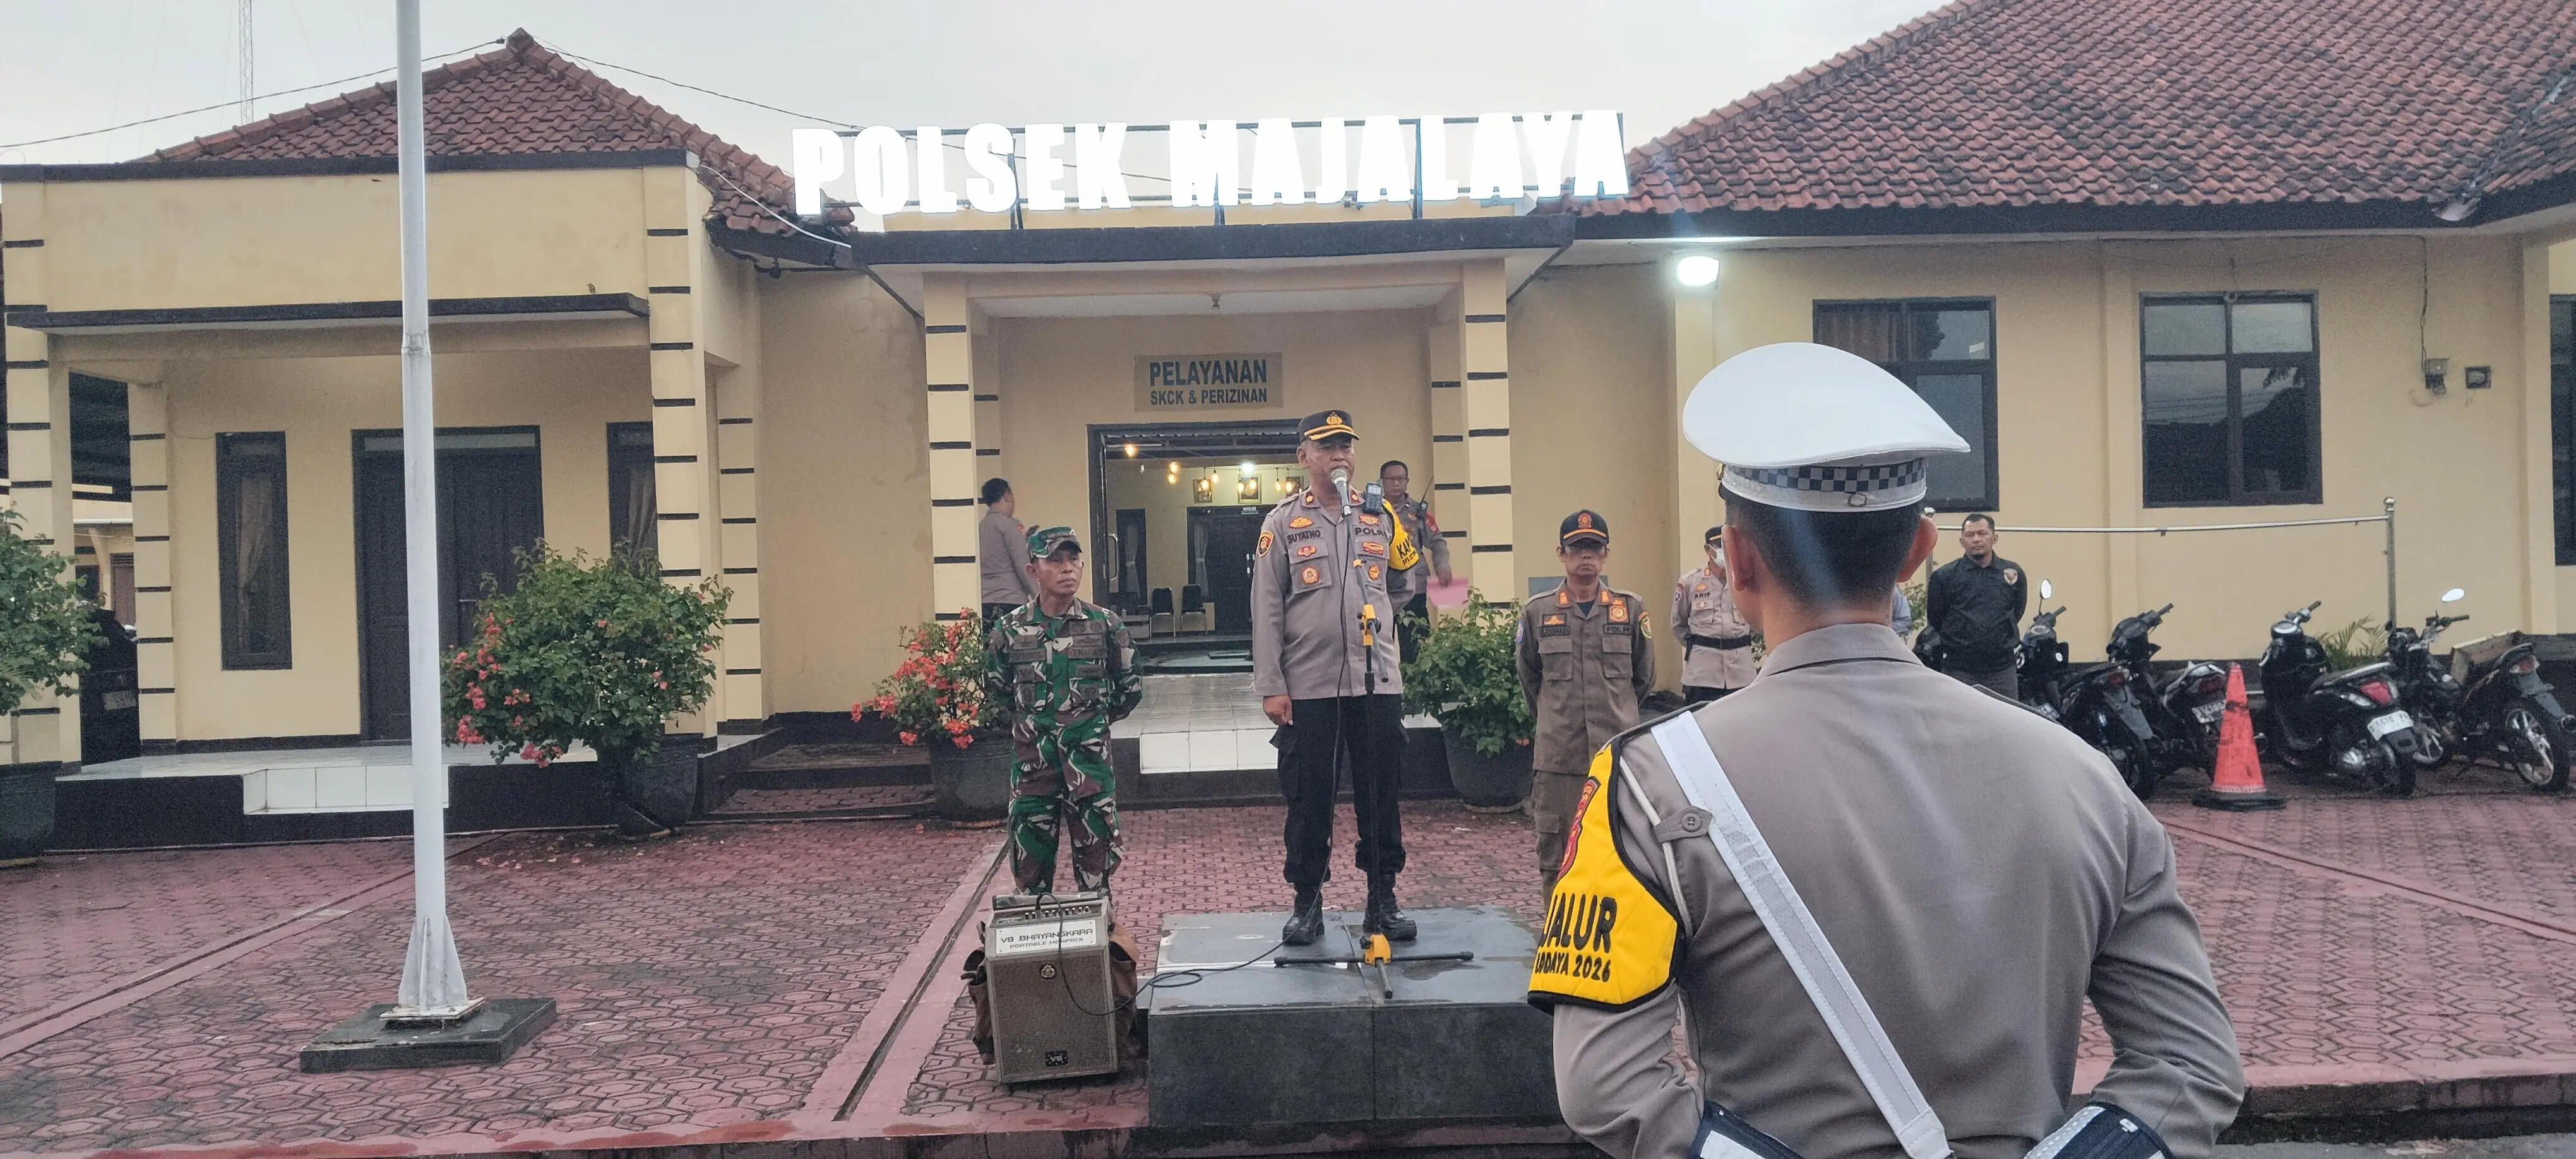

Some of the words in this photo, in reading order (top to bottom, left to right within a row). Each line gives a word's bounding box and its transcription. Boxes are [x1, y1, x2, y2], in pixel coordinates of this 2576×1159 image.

[792, 122, 1132, 216] POLSEK
[1169, 110, 1630, 207] MAJALAYA
[1149, 359, 1267, 386] PELAYANAN
[1150, 389, 1184, 405] SKCK
[1188, 389, 1197, 404] &
[1201, 388, 1267, 404] PERIZINAN
[1019, 928, 1093, 942] BHAYANGKARA
[1539, 893, 1618, 954] JALUR
[1010, 941, 1047, 949] PORTABLE
[1572, 954, 1611, 983] 2026
